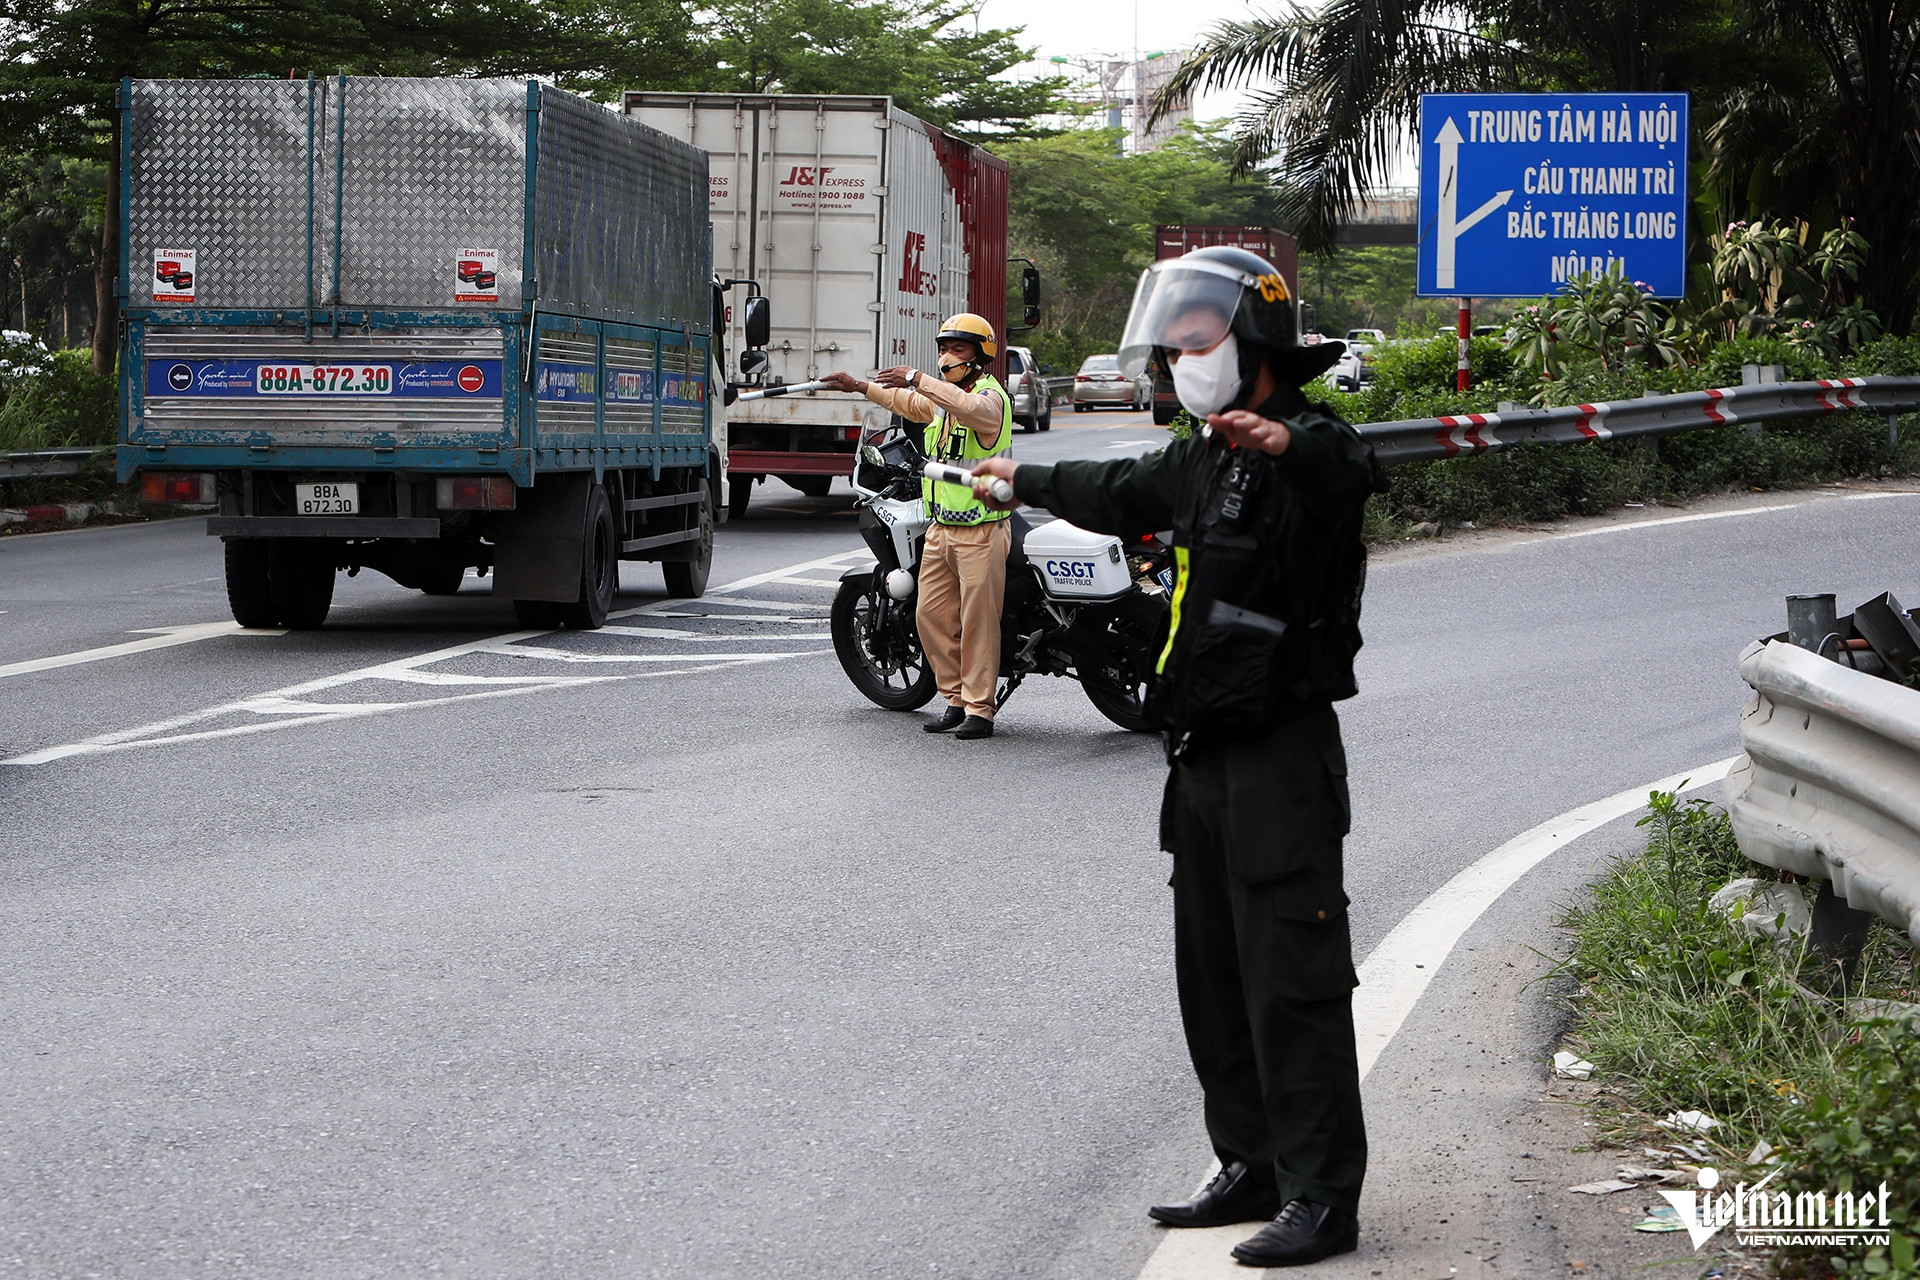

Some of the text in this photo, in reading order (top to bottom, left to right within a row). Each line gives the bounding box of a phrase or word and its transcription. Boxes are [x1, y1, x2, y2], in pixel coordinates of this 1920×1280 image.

[1468, 103, 1678, 149] TRUNG TÂM HÀ NỘI
[780, 166, 865, 187] J&T EXPRESS
[1523, 159, 1675, 195] CẦU THANH TRÌ
[779, 190, 816, 199] Hotline:
[843, 192, 865, 200] 1088
[1507, 200, 1677, 239] BẮC THĂNG LONG
[163, 250, 193, 258] Enimac
[464, 249, 495, 258] Enimac
[260, 367, 389, 392] 88A-872.30
[313, 485, 340, 498] 88A
[303, 499, 352, 513] 872.30
[877, 506, 898, 526] CSGT
[1053, 577, 1093, 587] TRAFFIC POLICE
